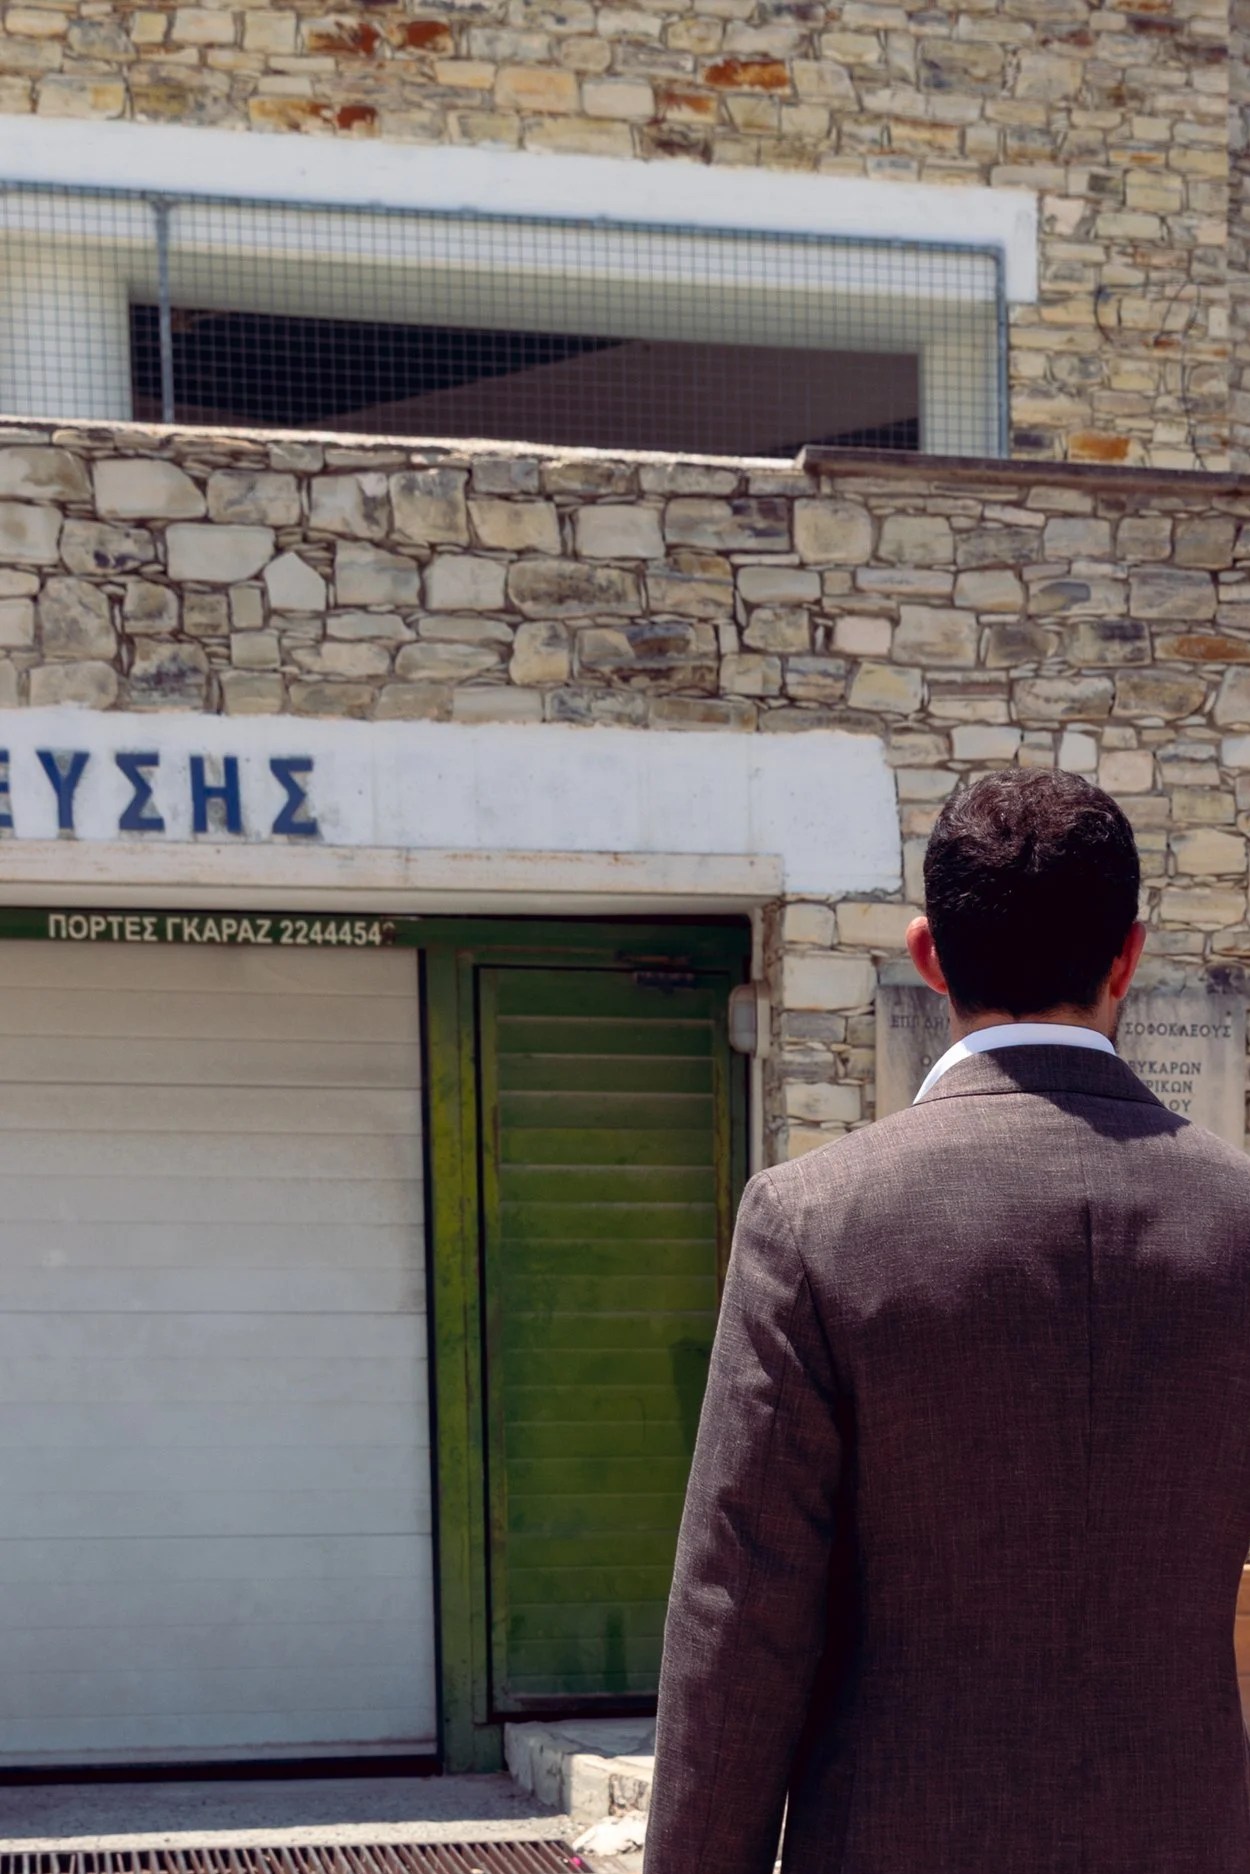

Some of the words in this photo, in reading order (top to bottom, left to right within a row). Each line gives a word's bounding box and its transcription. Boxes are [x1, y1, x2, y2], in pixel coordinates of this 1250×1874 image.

[48, 914, 158, 941] ΠΟΡΤΕΣ
[166, 917, 272, 943] ΓΚΑΡΑΖ
[1124, 1022, 1232, 1038] ΣΟΦΟΚΛΕΟΥΣ
